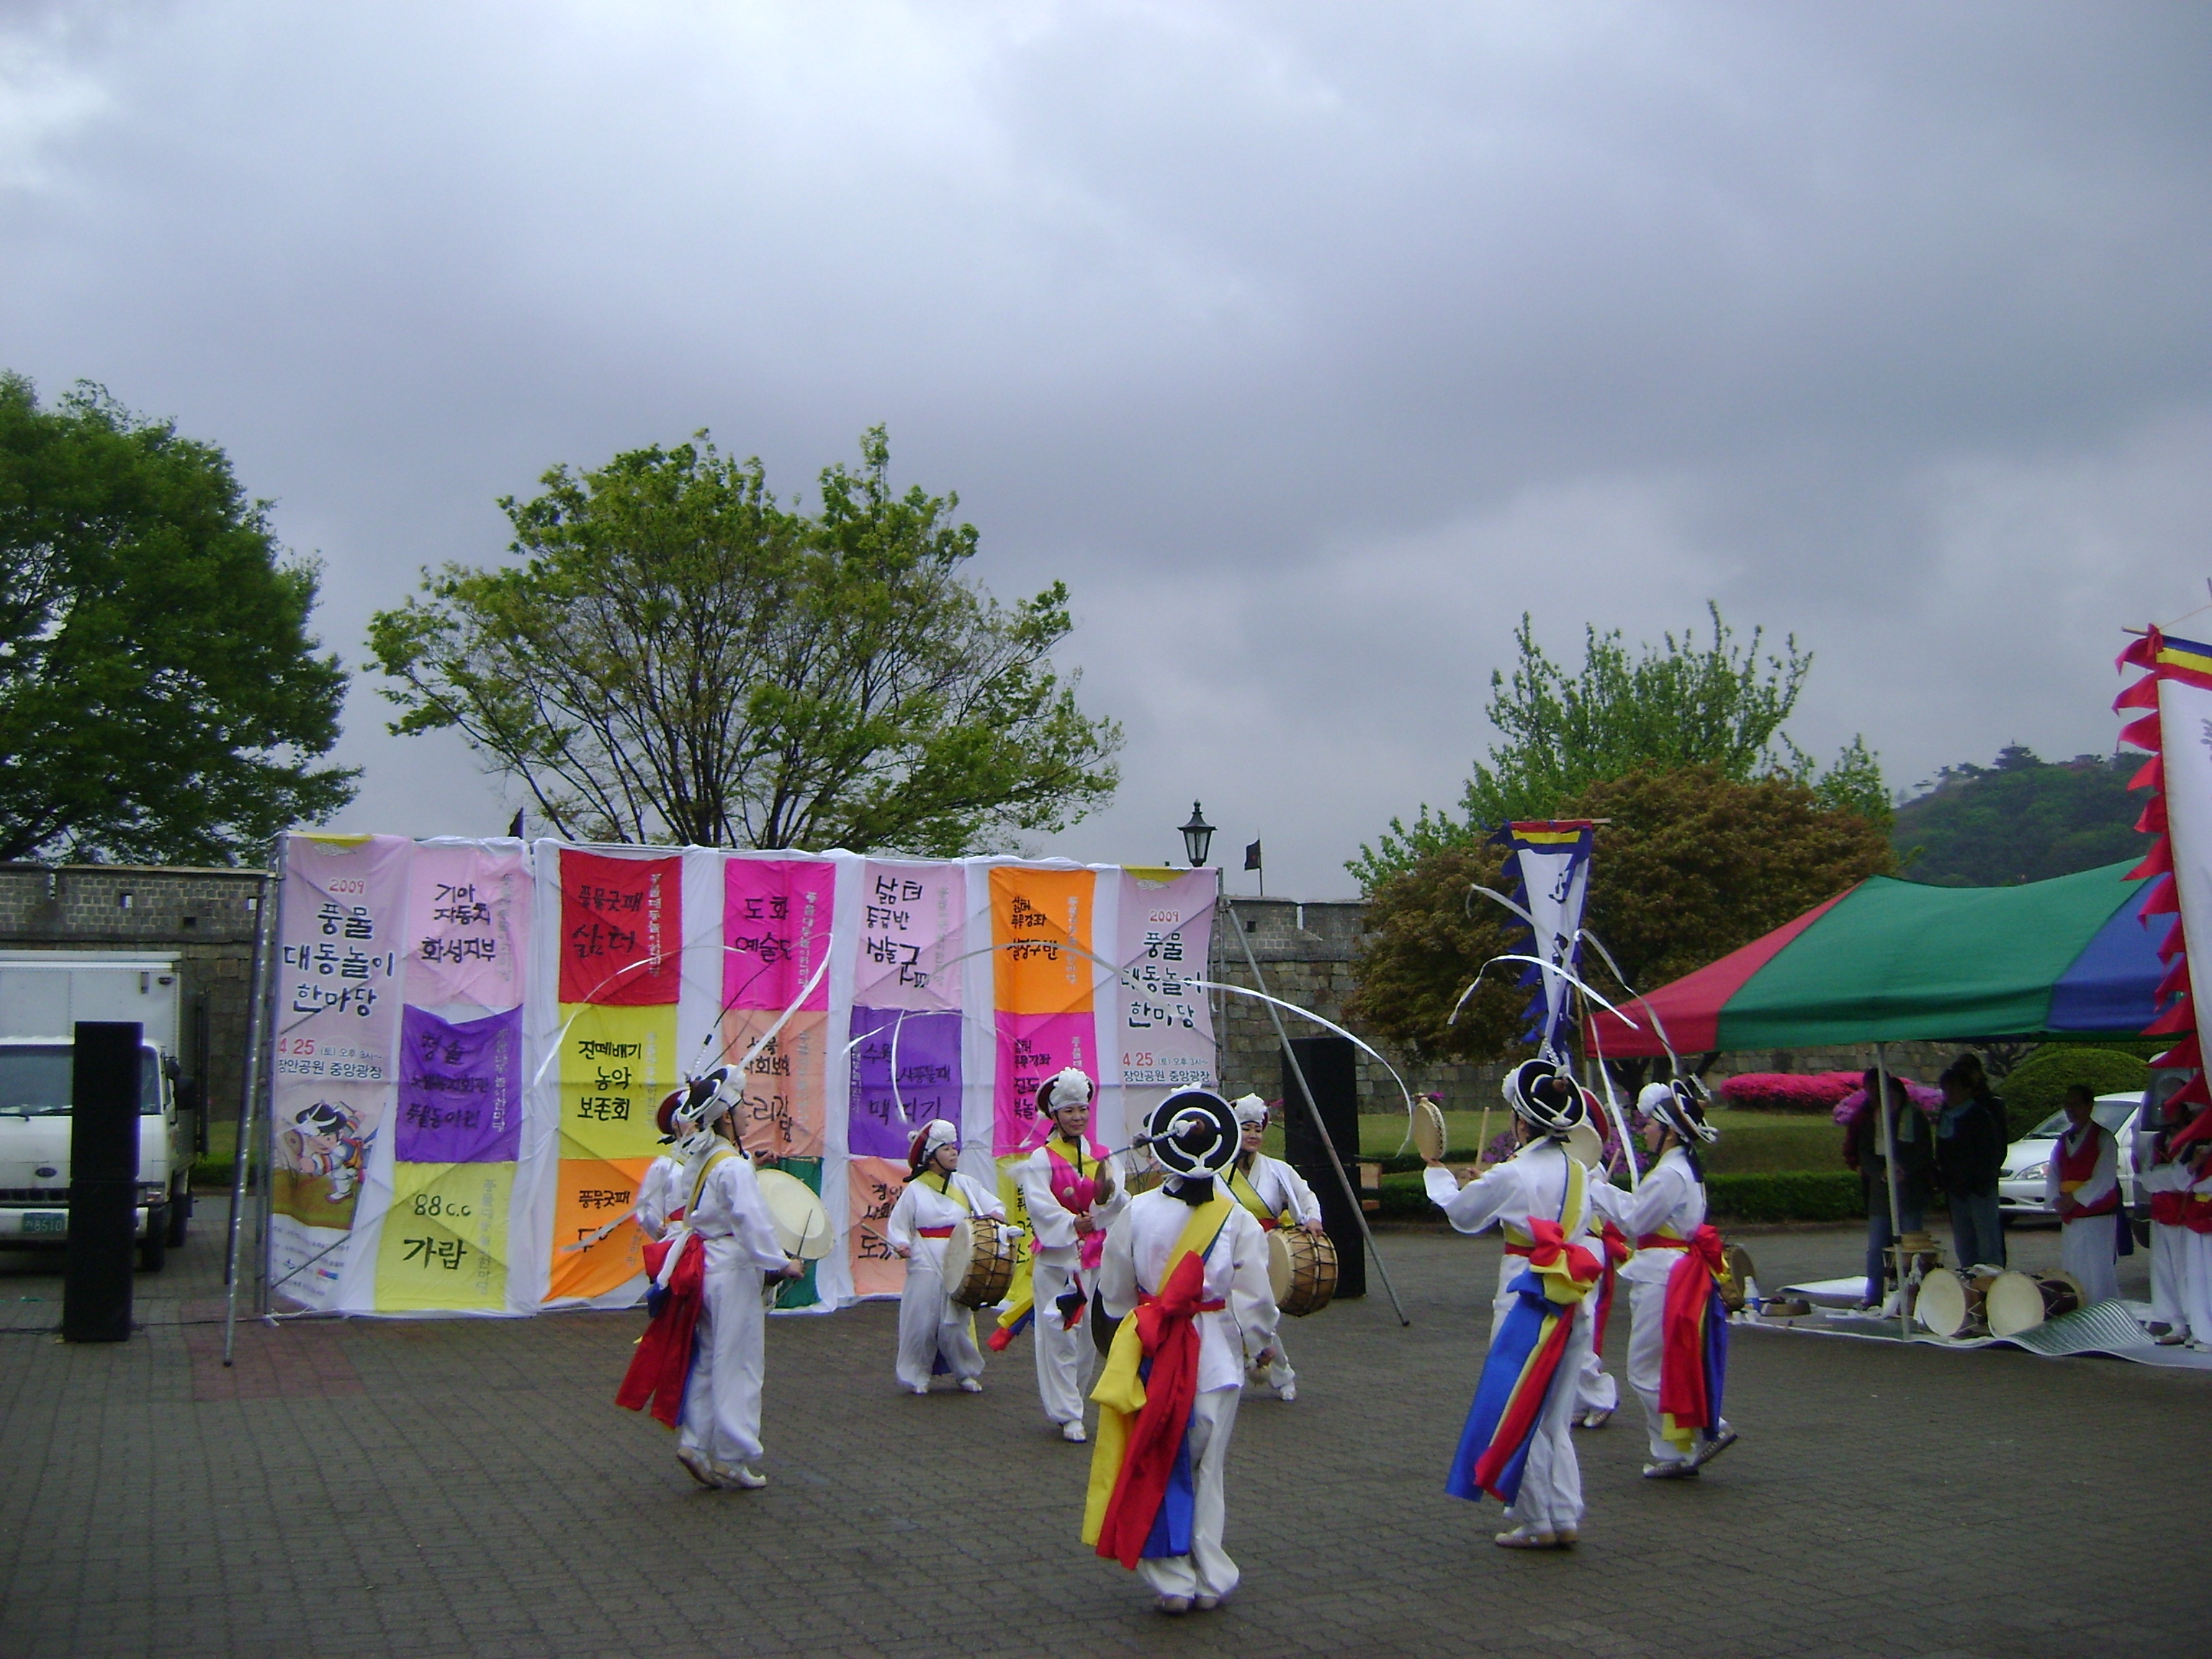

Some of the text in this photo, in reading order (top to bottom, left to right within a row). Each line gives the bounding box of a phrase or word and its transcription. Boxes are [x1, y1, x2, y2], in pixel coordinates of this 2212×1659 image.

[329, 878, 365, 894] 2009
[434, 884, 476, 903] 기아
[578, 884, 644, 912] 풍물굿패
[876, 875, 923, 904] 삶터
[745, 896, 789, 920] 도화
[1149, 910, 1179, 922] 2009
[317, 903, 373, 940] 풍물
[421, 935, 496, 963] 화성지부
[571, 922, 637, 959] 삶터
[1143, 931, 1183, 961] 풍물
[284, 943, 394, 979] 대동놀이
[292, 983, 377, 1017] 한마당
[340, 1047, 357, 1058] 오후
[1173, 1057, 1188, 1066] 오후
[278, 1059, 383, 1079] 장안공원 중앙광장
[594, 1066, 632, 1091] 농악
[1123, 1069, 1210, 1083] 장안공원 중앙광장
[577, 1096, 631, 1122] 보존회
[1014, 1097, 1039, 1120] 북놀
[578, 1190, 631, 1210] 풍물굿패
[403, 1236, 468, 1270] 가람
